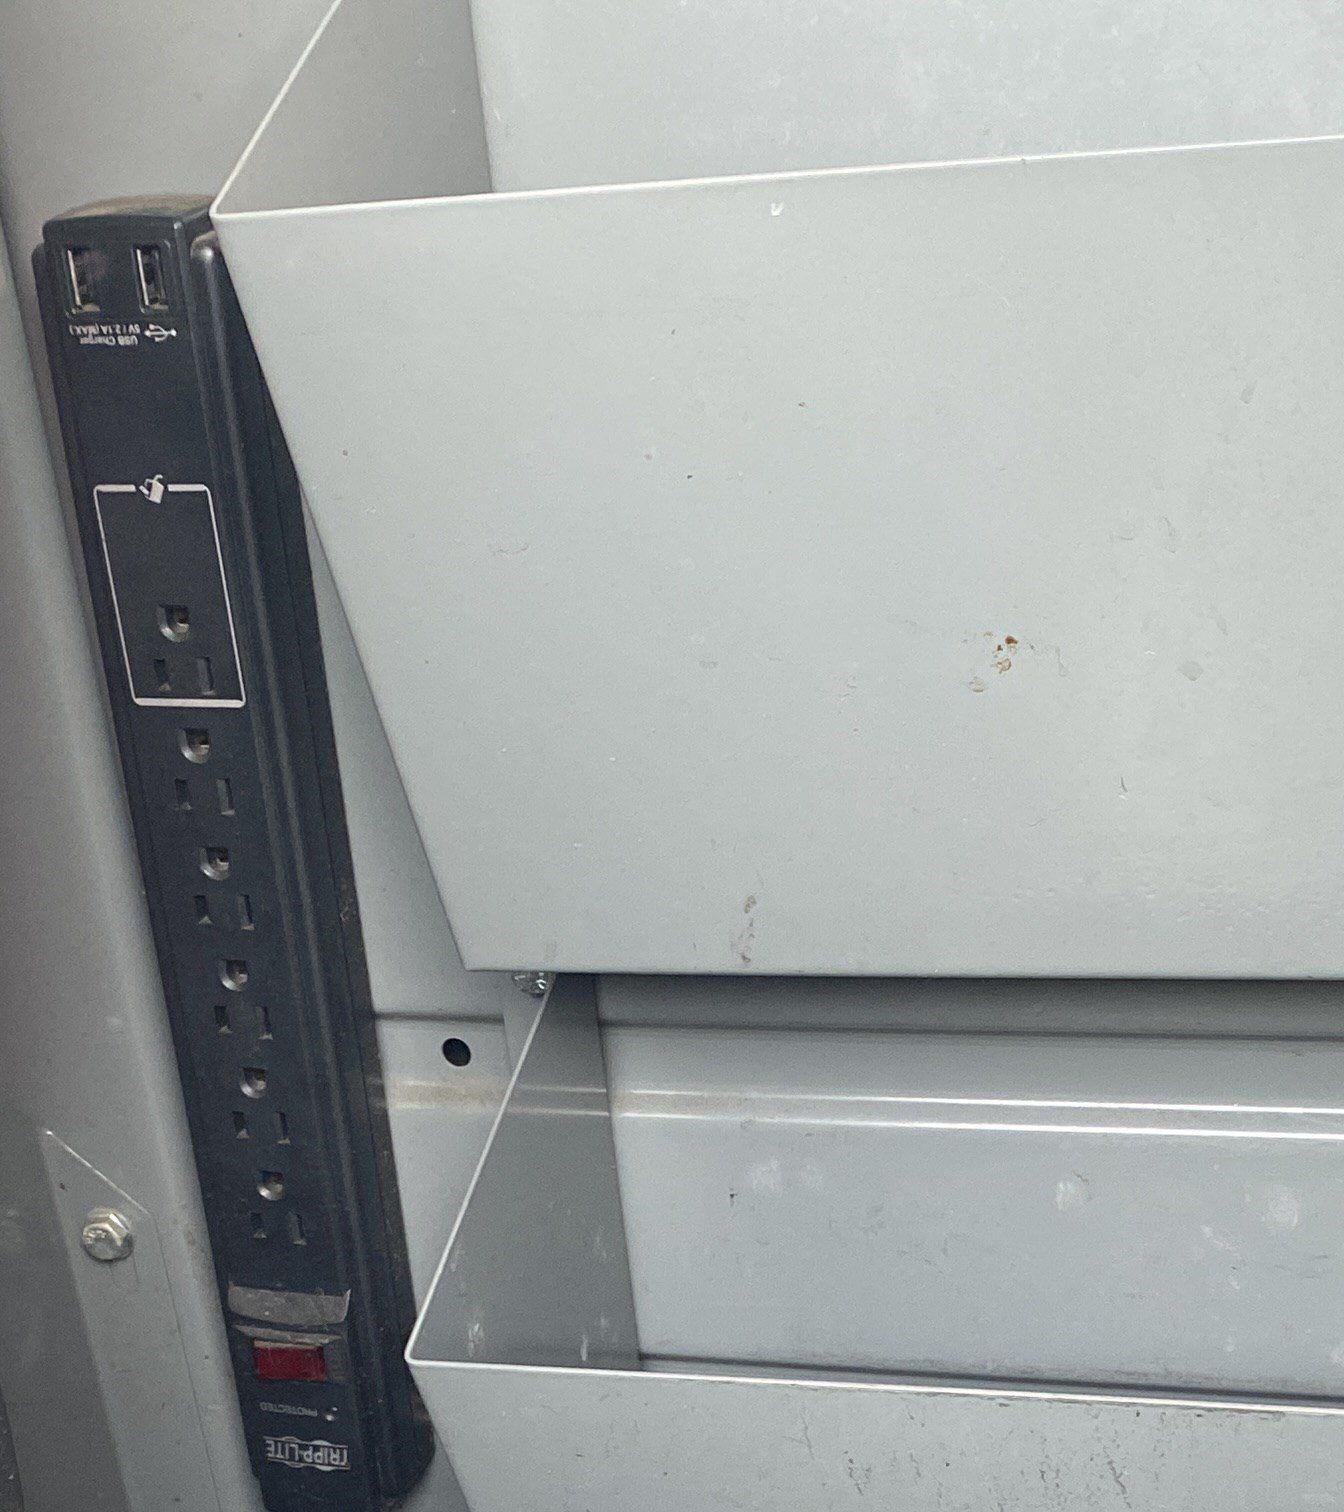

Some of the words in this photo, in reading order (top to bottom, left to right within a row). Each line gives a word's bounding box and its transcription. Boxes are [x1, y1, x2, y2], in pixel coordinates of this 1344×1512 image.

[128, 324, 141, 334] 5V
[80, 331, 116, 346] Charger
[117, 335, 138, 346] USB
[259, 1402, 318, 1417] PROTECTED
